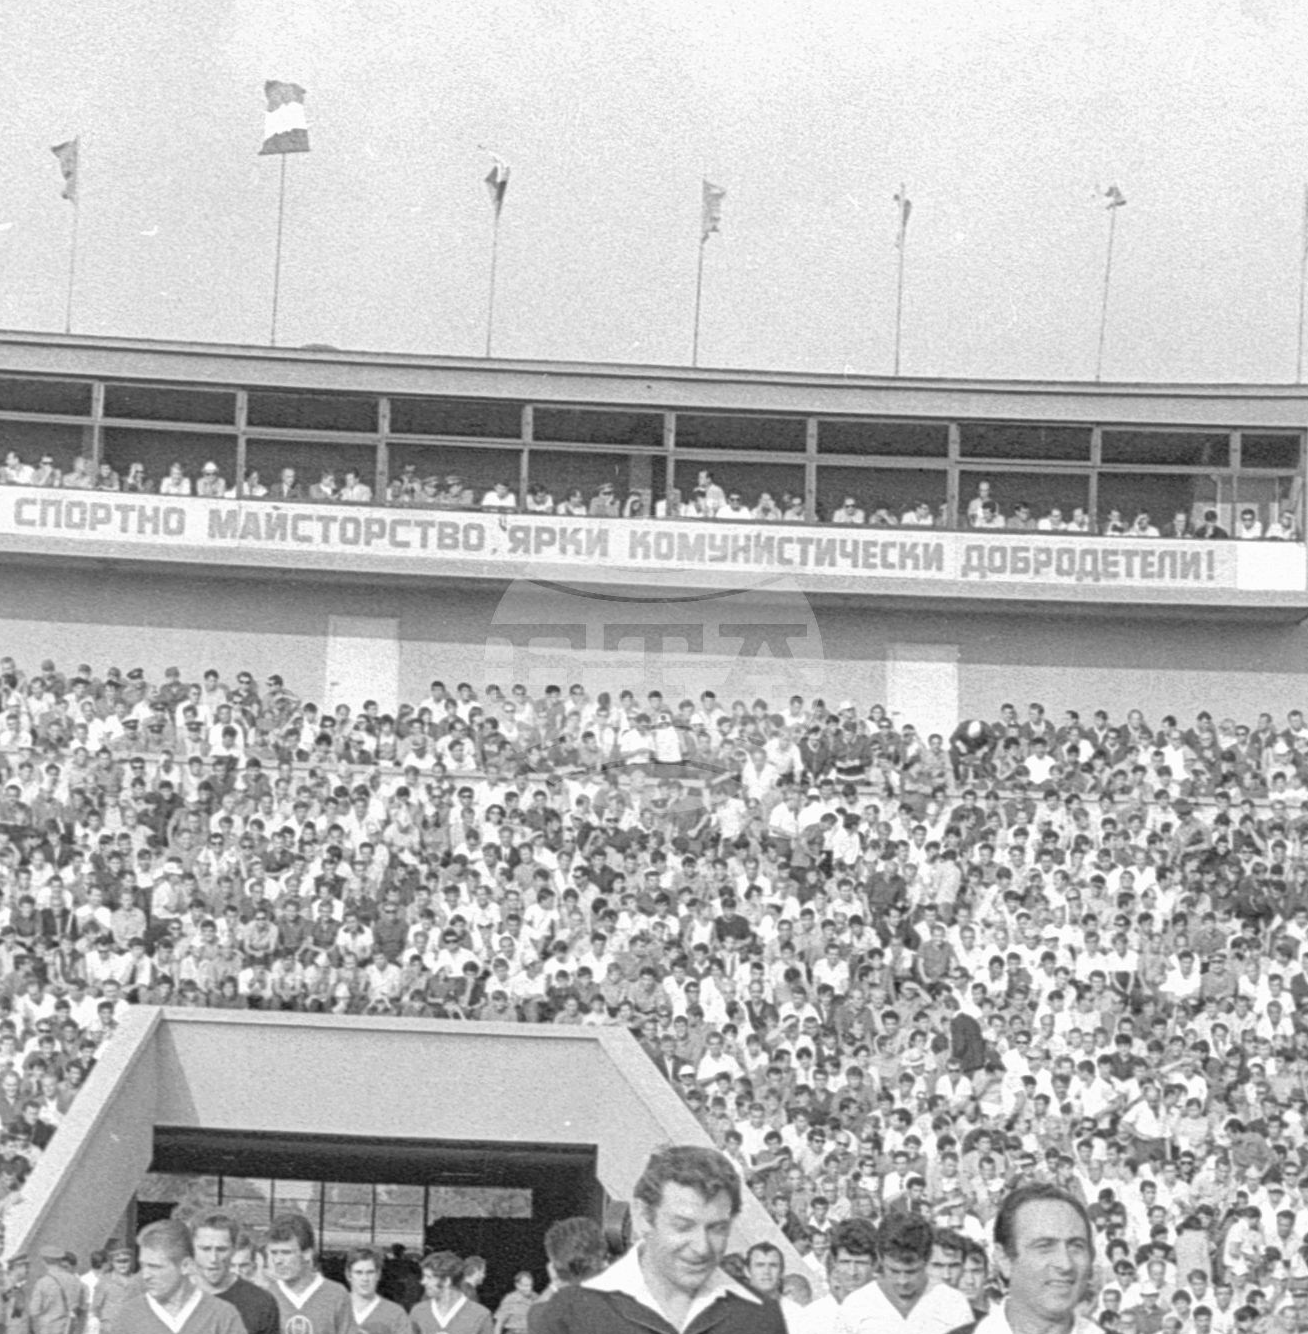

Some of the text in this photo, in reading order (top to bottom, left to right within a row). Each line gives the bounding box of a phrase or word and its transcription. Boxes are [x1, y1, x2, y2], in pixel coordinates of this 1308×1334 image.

[13, 496, 186, 536] СПОРТНО
[207, 505, 498, 555] МАЙСТОРСТВО,
[507, 524, 610, 559] ЯРКИ
[627, 529, 945, 573] КОМУНИСТИЧЕСКИ
[960, 543, 1216, 583] ДОБРОДЕТЕЛИ!
